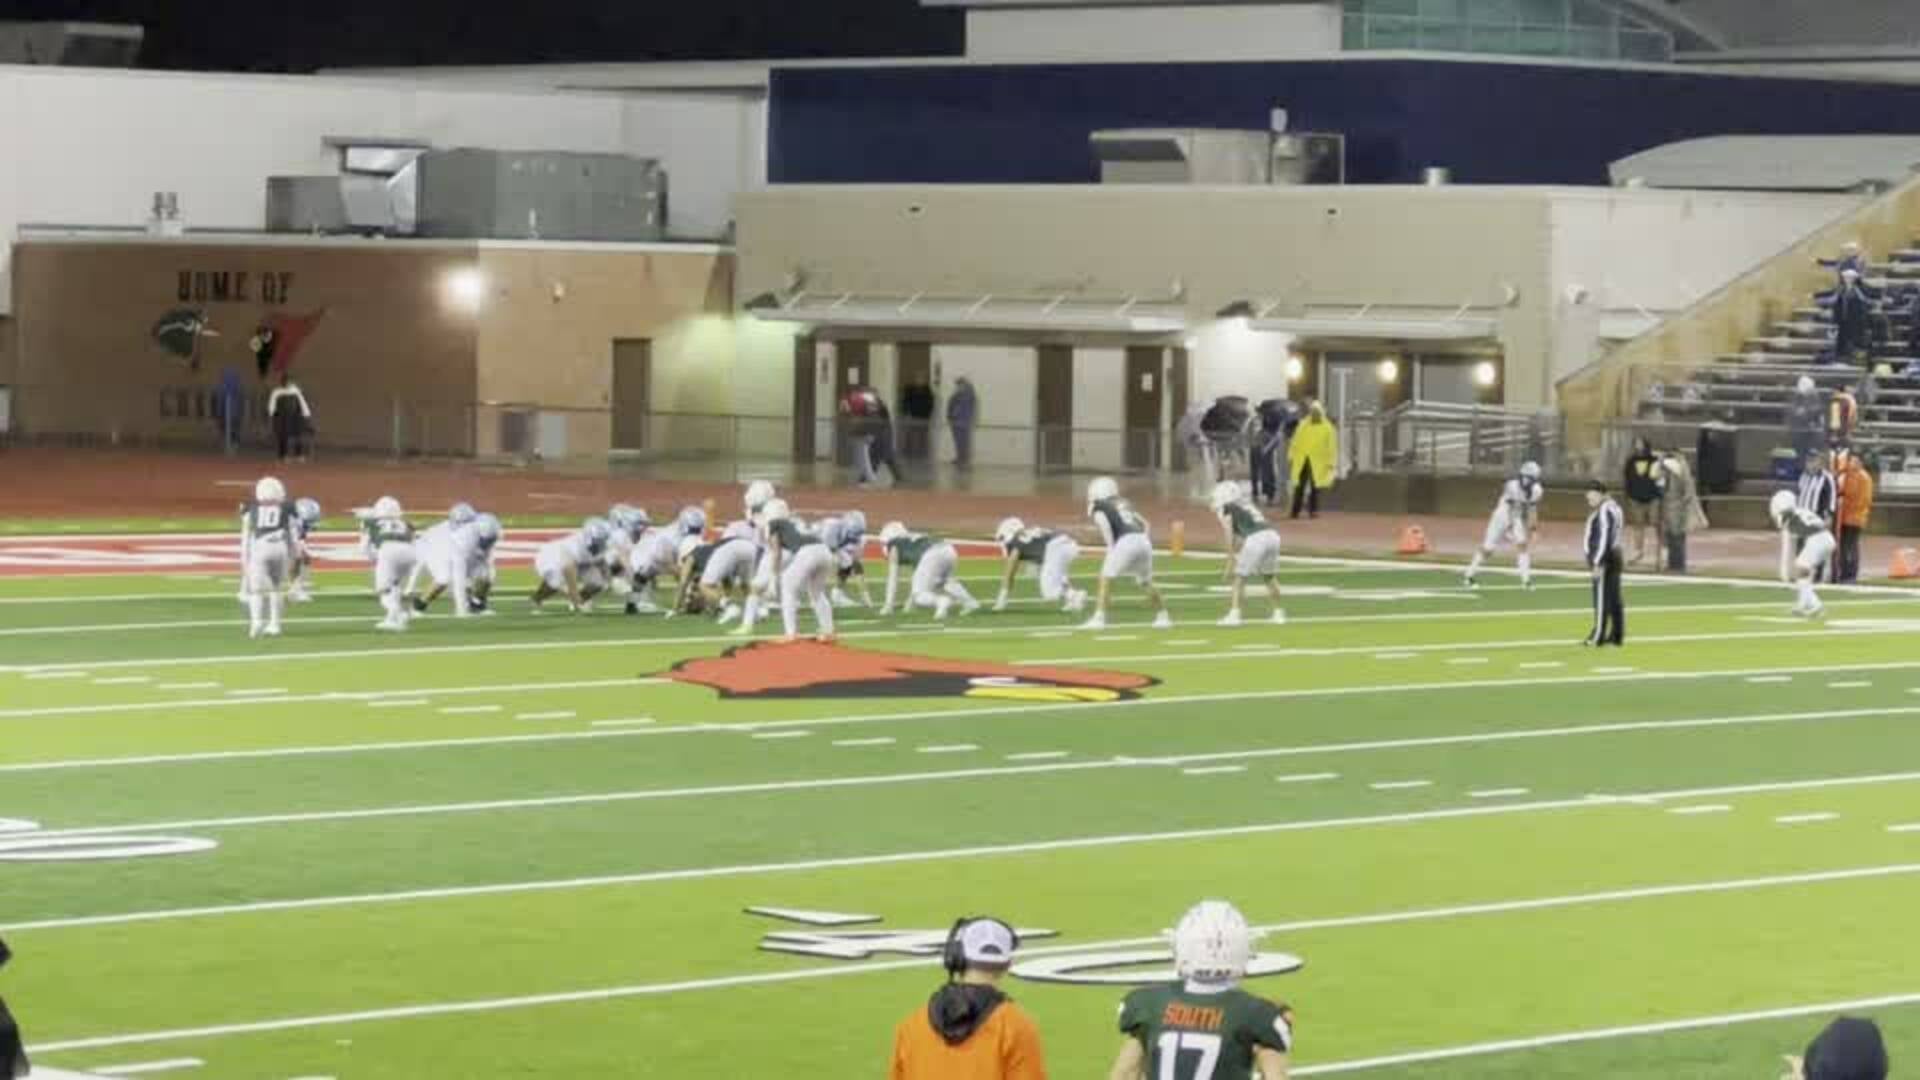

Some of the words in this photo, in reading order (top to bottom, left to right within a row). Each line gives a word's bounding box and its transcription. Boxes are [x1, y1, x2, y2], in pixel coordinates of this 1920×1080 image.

[256, 505, 281, 527] 10
[1162, 1002, 1224, 1029] SOUTH
[1157, 1031, 1222, 1080] 17
